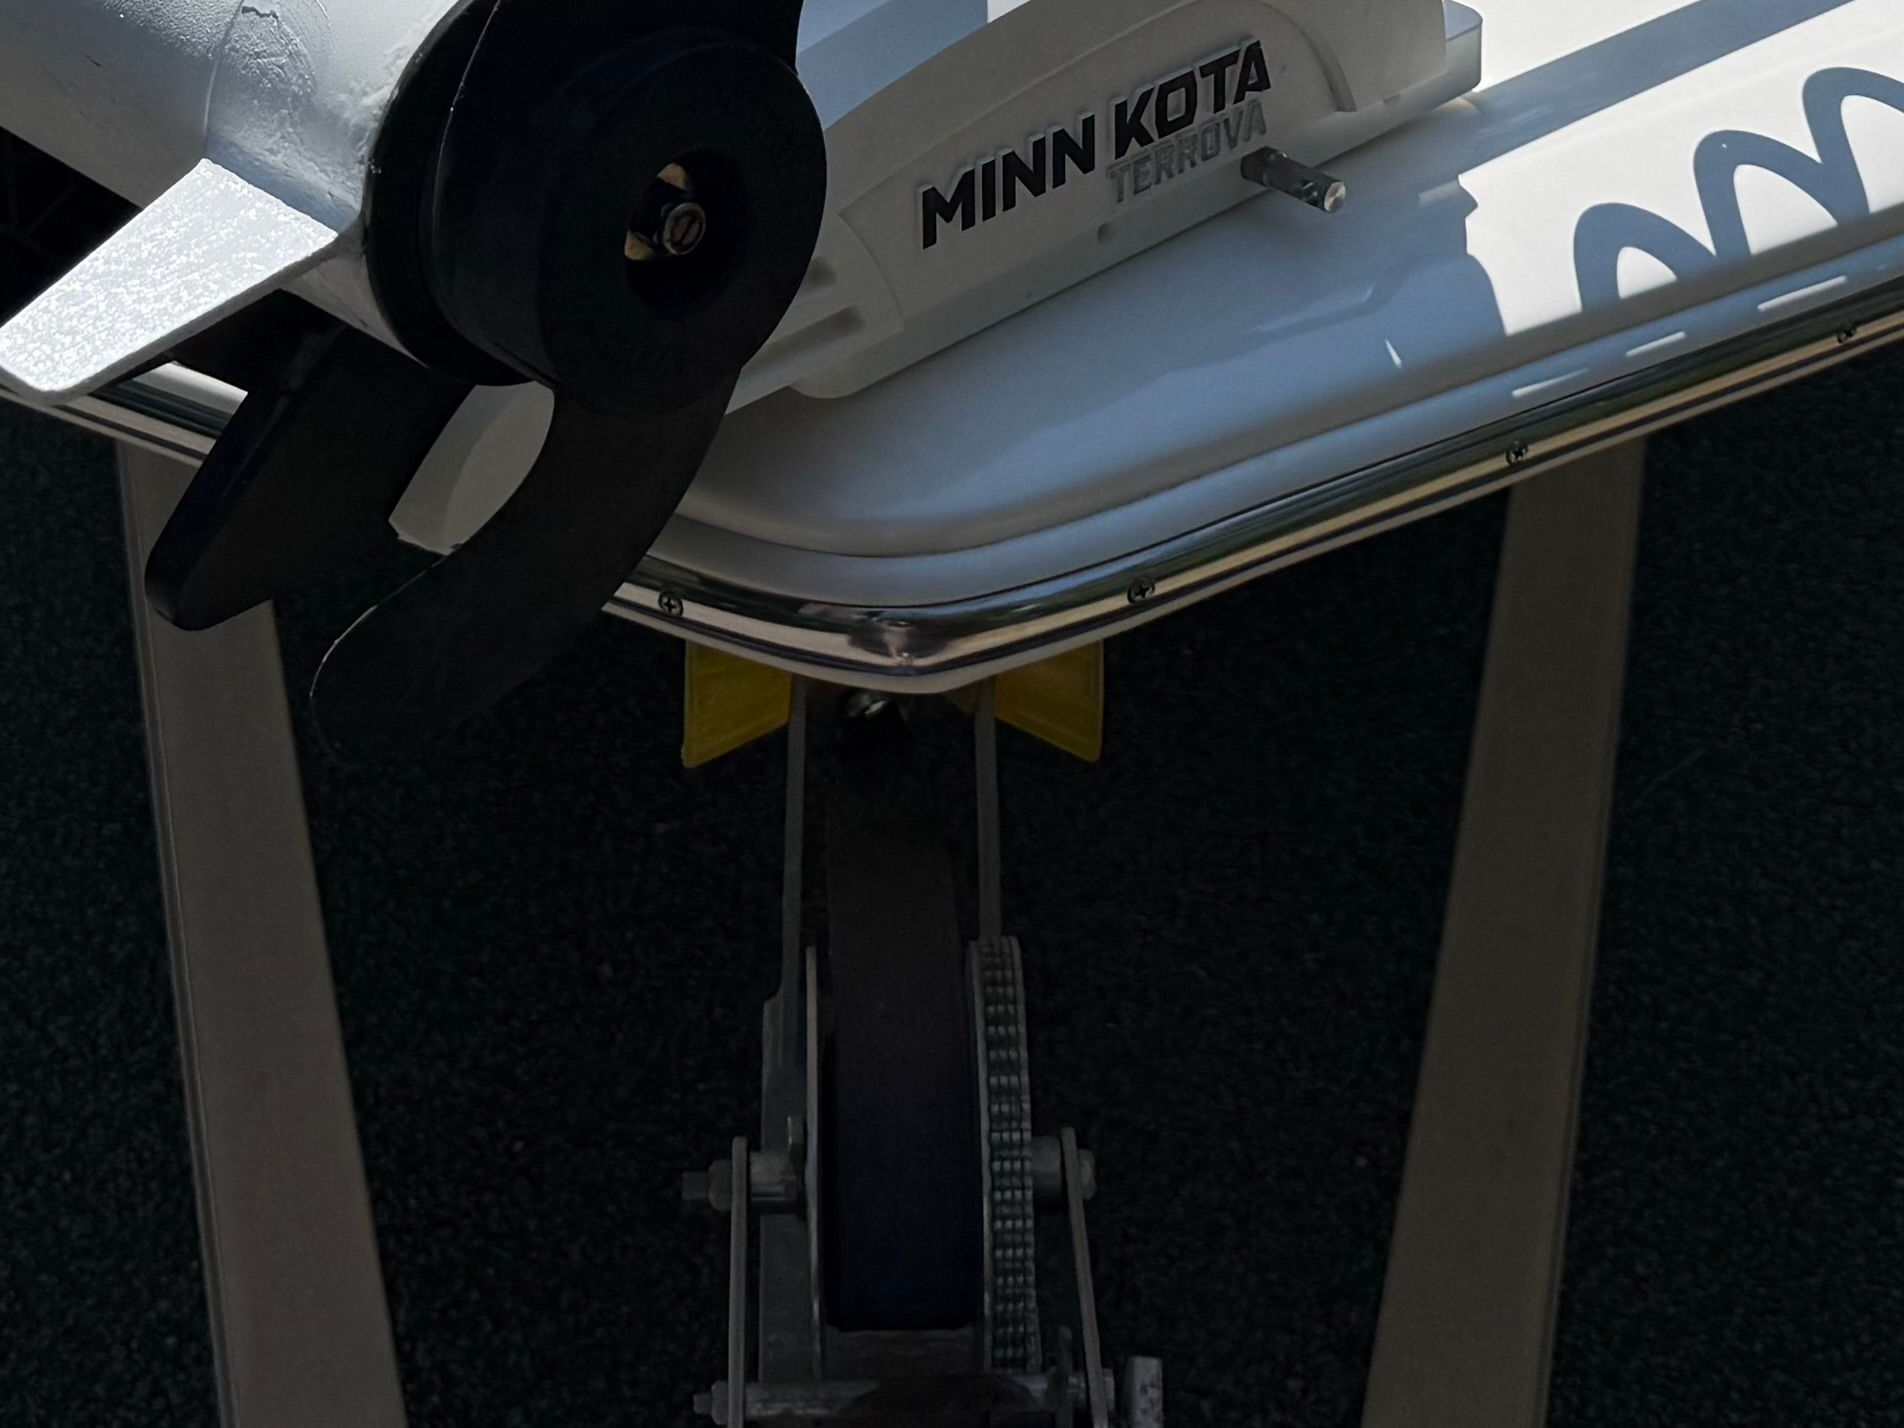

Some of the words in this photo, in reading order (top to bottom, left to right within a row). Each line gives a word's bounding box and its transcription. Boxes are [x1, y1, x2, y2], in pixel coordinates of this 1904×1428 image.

[920, 113, 1097, 249] MINN
[1113, 38, 1272, 160] KOTA
[1106, 97, 1268, 204] TERROVA
